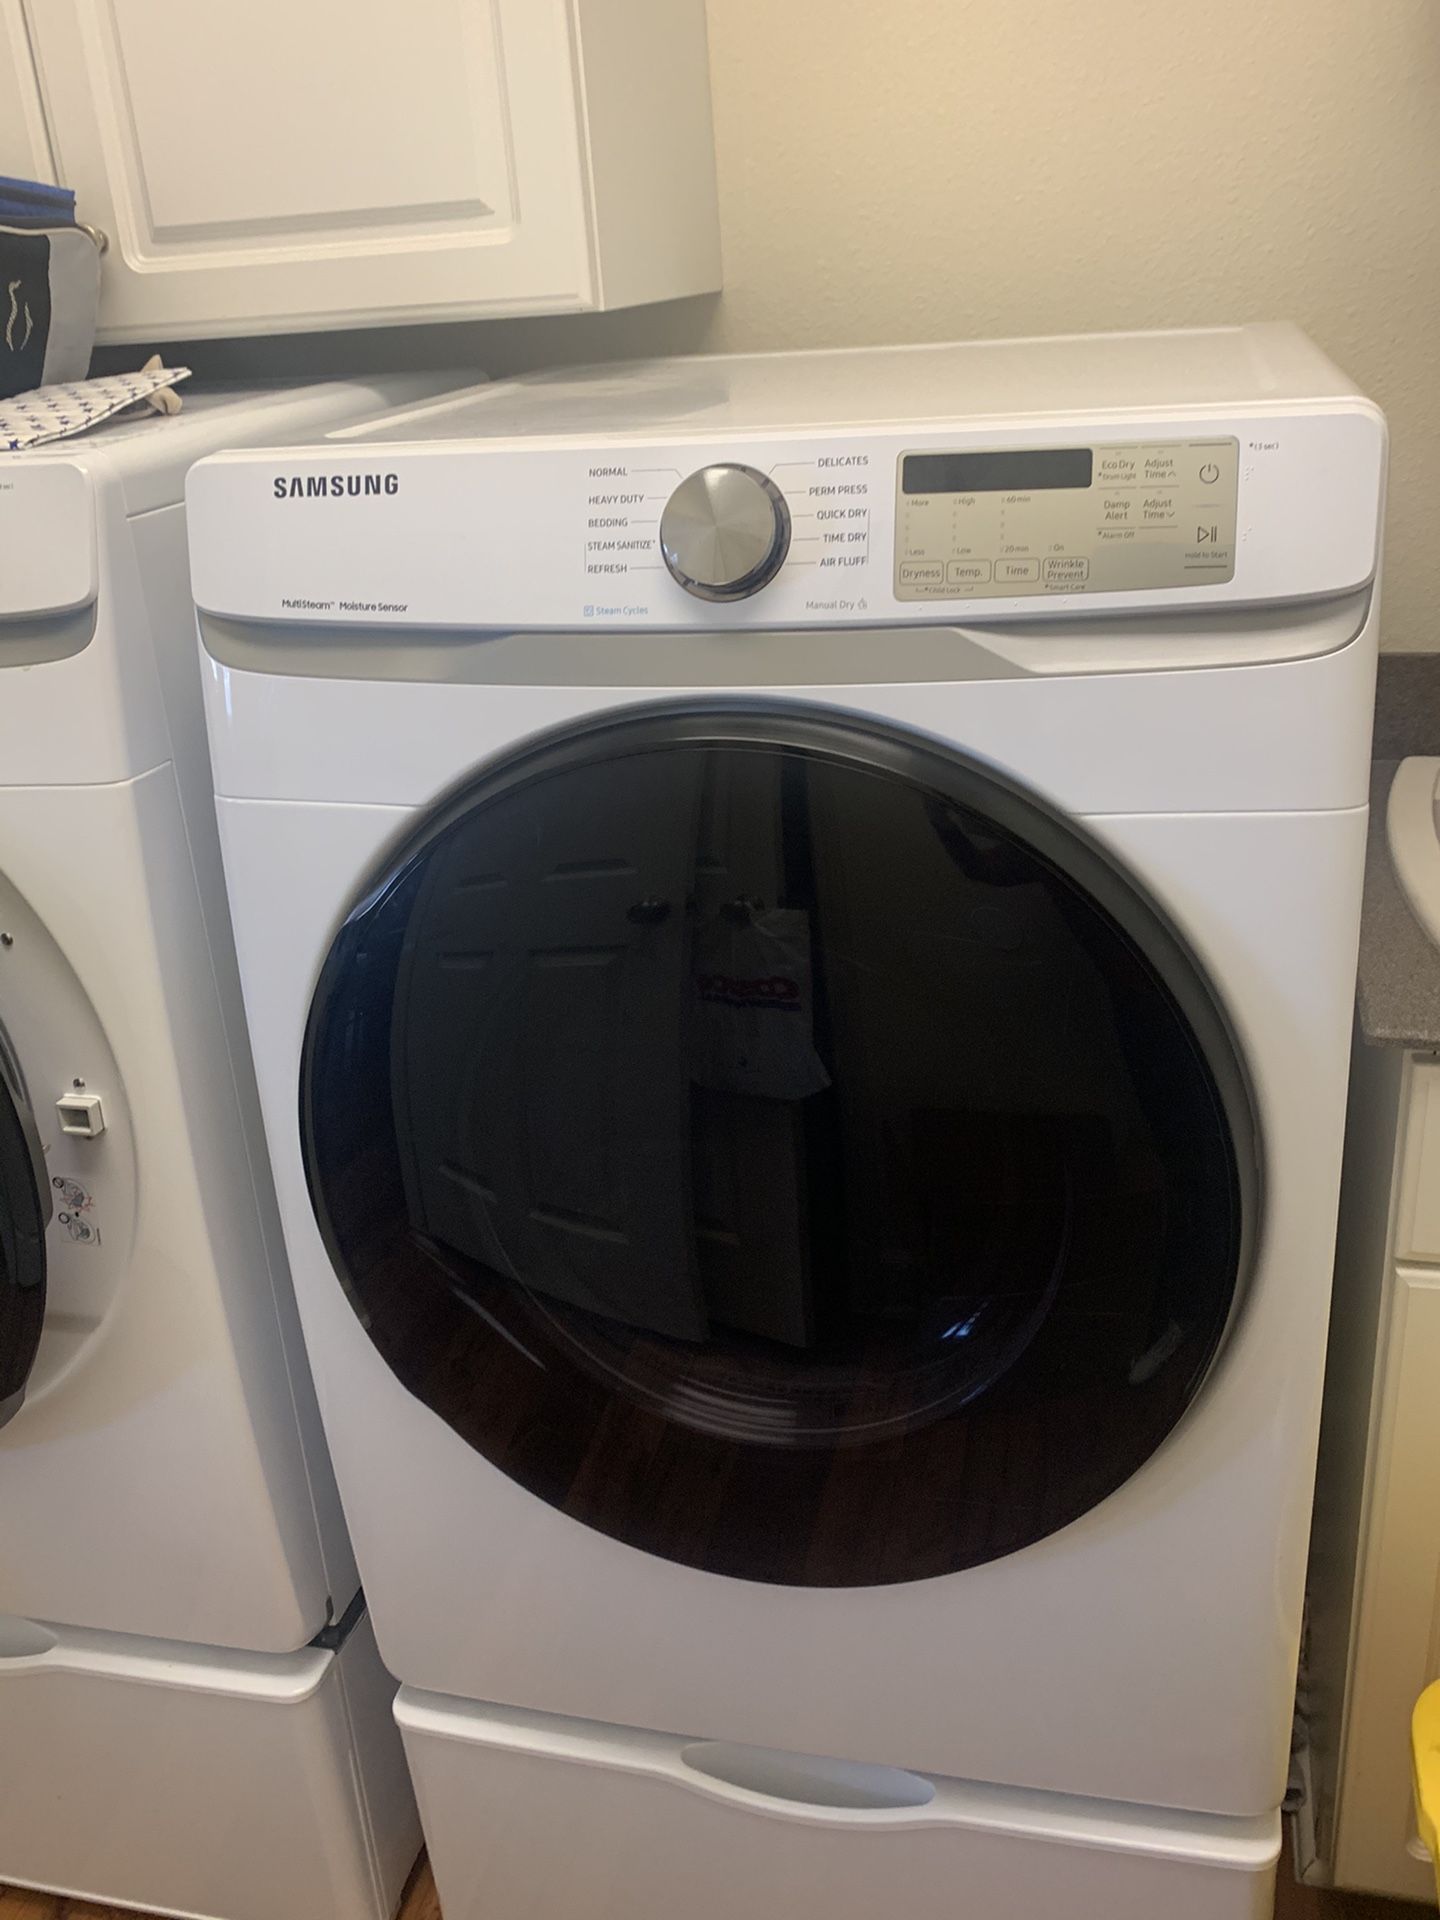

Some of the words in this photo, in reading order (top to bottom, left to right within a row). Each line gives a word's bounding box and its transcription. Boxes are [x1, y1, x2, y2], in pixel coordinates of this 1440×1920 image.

[817, 456, 869, 468] DELICATES
[1102, 462, 1118, 470] Eco
[1119, 460, 1136, 471] Dry
[1144, 459, 1173, 471] Adjust
[588, 467, 628, 478] NORMAL
[1145, 470, 1167, 479] Time
[273, 473, 399, 498] SAMSUNG
[808, 486, 836, 496] PERM
[838, 484, 868, 495] PRESS
[588, 494, 619, 505] HEAVY
[620, 493, 645, 504] DUTY
[1104, 500, 1131, 511] Damp
[1143, 499, 1172, 511] Adjust
[816, 509, 847, 521] QUICK
[848, 508, 868, 519] DRY
[1105, 511, 1129, 520] Alert
[1143, 511, 1166, 520] Time
[588, 517, 629, 528] BEDDING
[823, 533, 846, 544] TIME
[847, 532, 867, 543] DRY
[587, 540, 616, 551] STEAM
[820, 558, 836, 569] AIR
[838, 556, 866, 568] FLUFF
[1049, 560, 1085, 571] Wrinkle
[587, 564, 628, 574] REFRESH
[902, 568, 942, 581] Dryness
[955, 567, 983, 580] Temp.
[1006, 566, 1030, 577] Time
[1047, 571, 1084, 581] Prevent
[339, 601, 377, 613] Moisture
[377, 603, 409, 614] Sensor
[595, 606, 621, 616] Steam
[622, 605, 649, 617] Cycles
[805, 600, 838, 611] Manual
[839, 600, 855, 611] Dry
